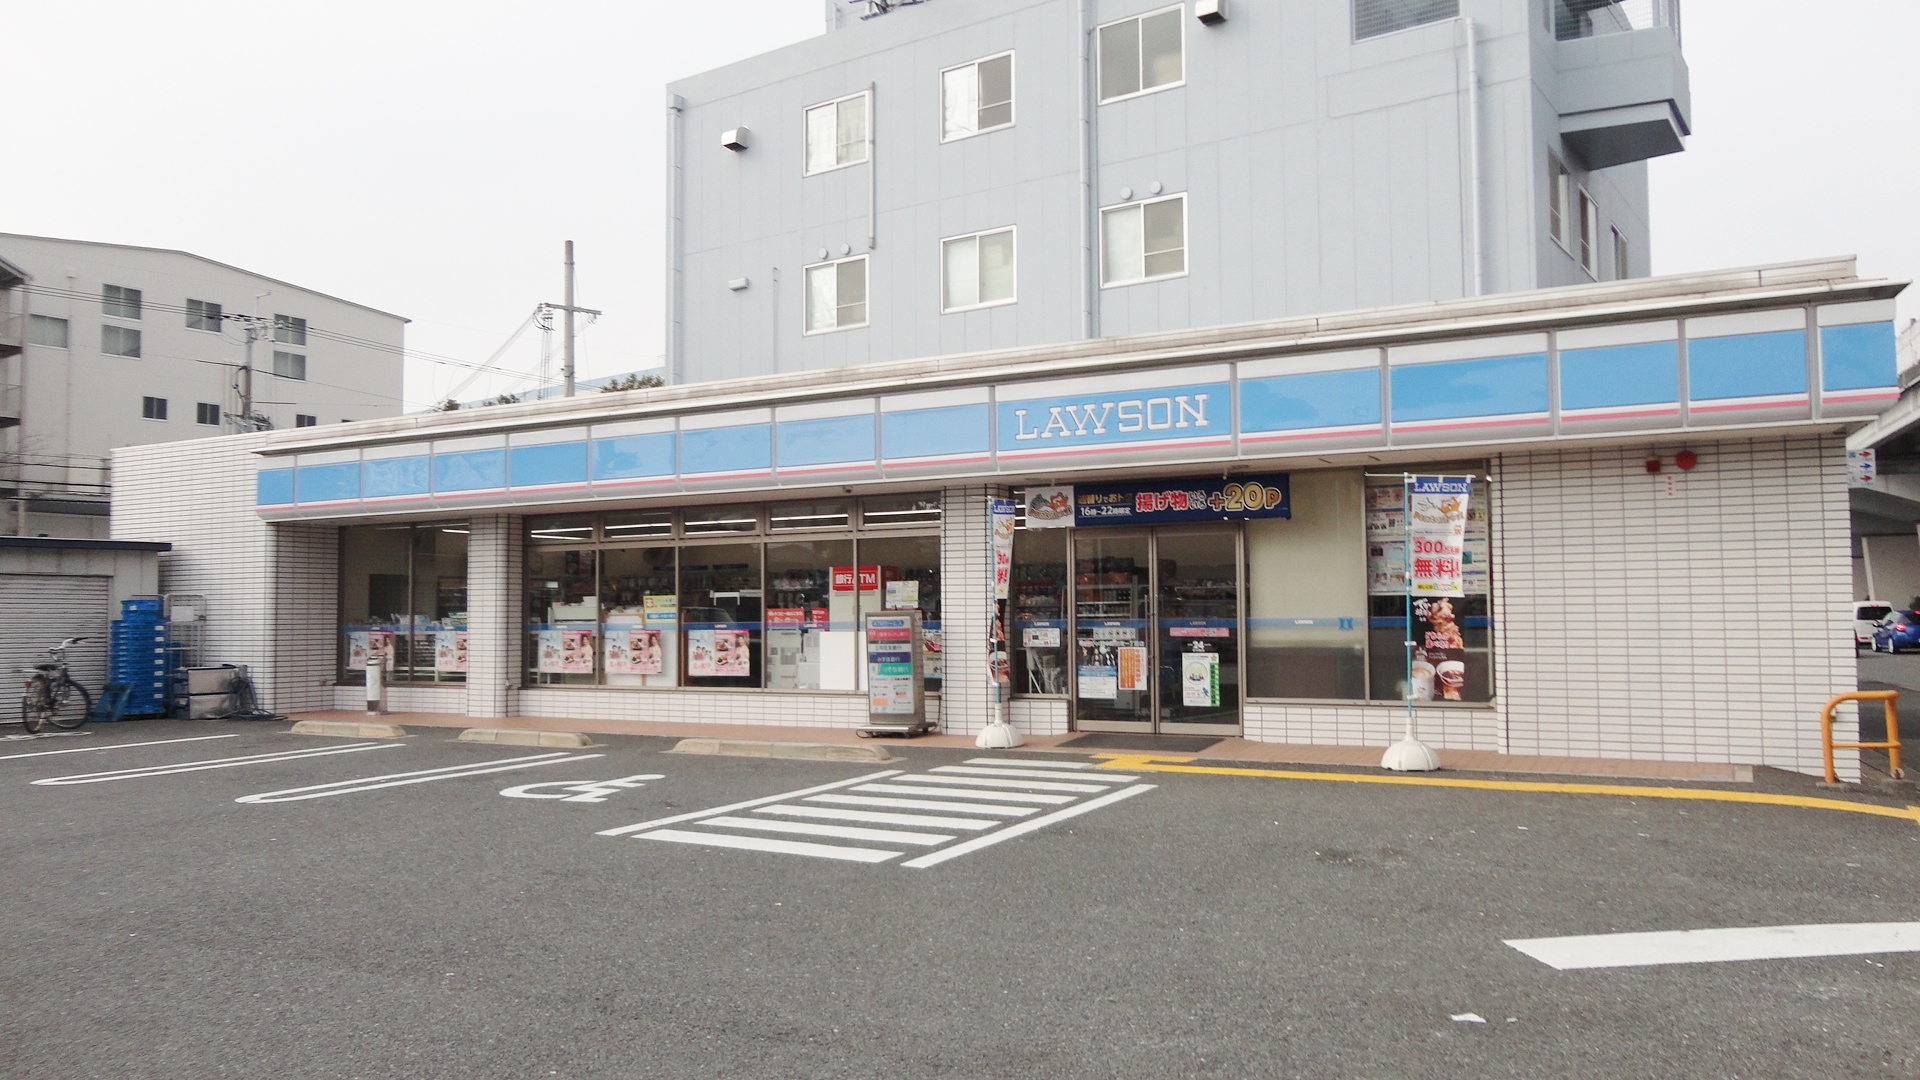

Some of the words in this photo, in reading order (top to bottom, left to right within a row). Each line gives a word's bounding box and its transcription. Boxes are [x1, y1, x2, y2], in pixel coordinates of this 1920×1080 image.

[1014, 393, 1210, 441] LAWSON
[1413, 482, 1468, 493] LAWSON
[1414, 540, 1444, 554] 300
[835, 573, 876, 585] 銀行TM
